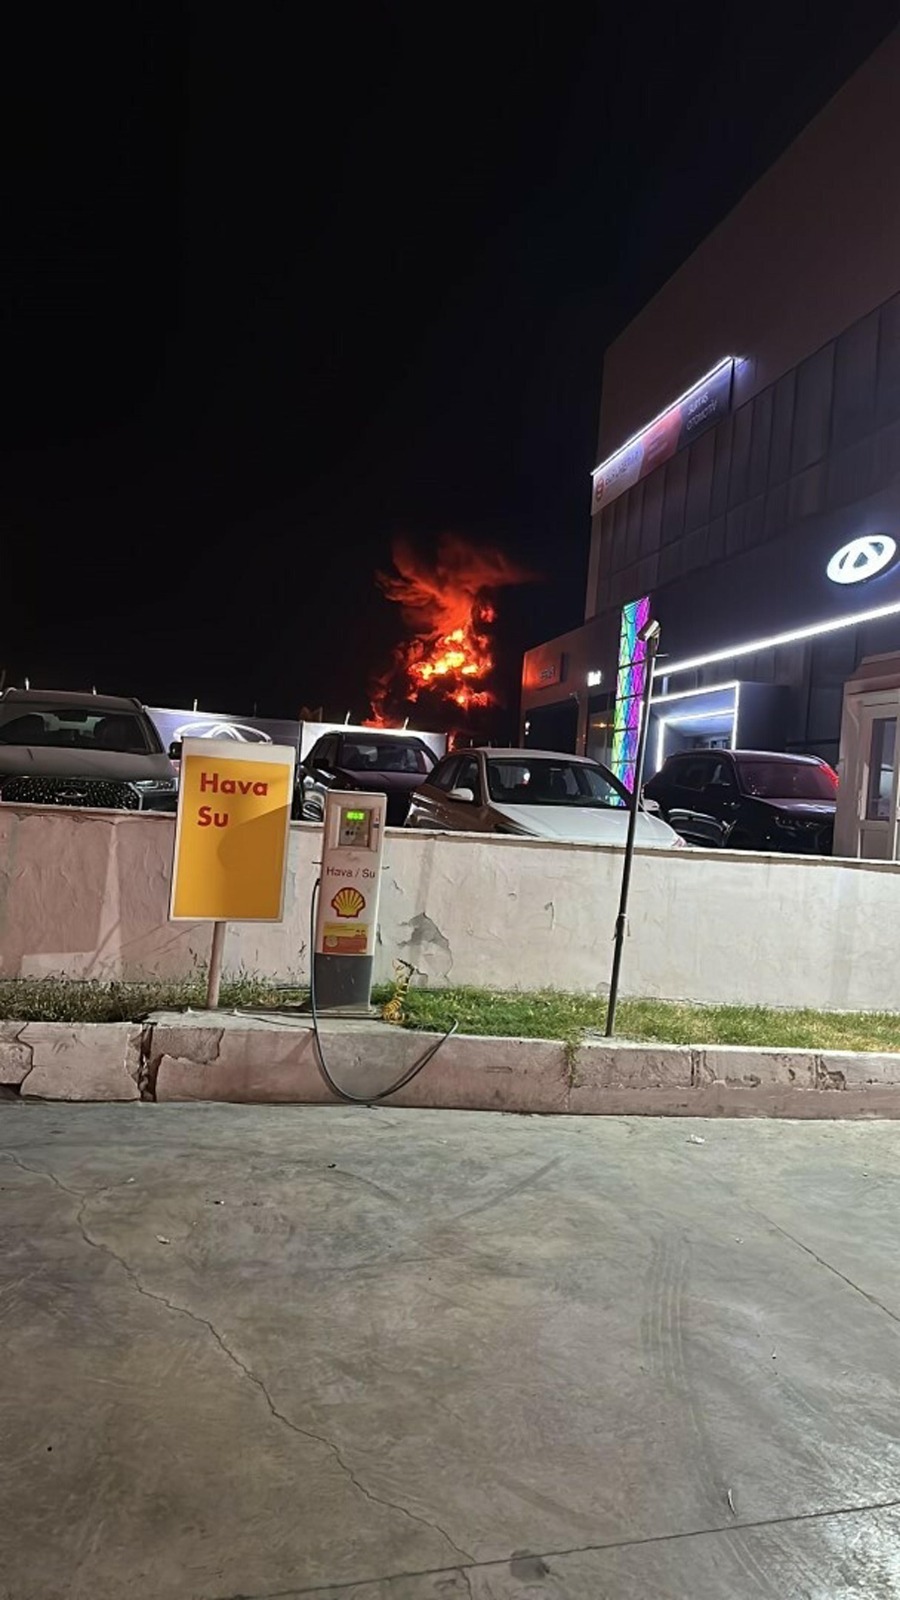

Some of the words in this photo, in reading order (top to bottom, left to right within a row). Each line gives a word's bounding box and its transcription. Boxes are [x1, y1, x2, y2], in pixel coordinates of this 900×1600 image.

[200, 772, 268, 797] Hava
[197, 805, 229, 828] Su
[326, 866, 353, 878] Hava
[362, 868, 376, 878] Su
